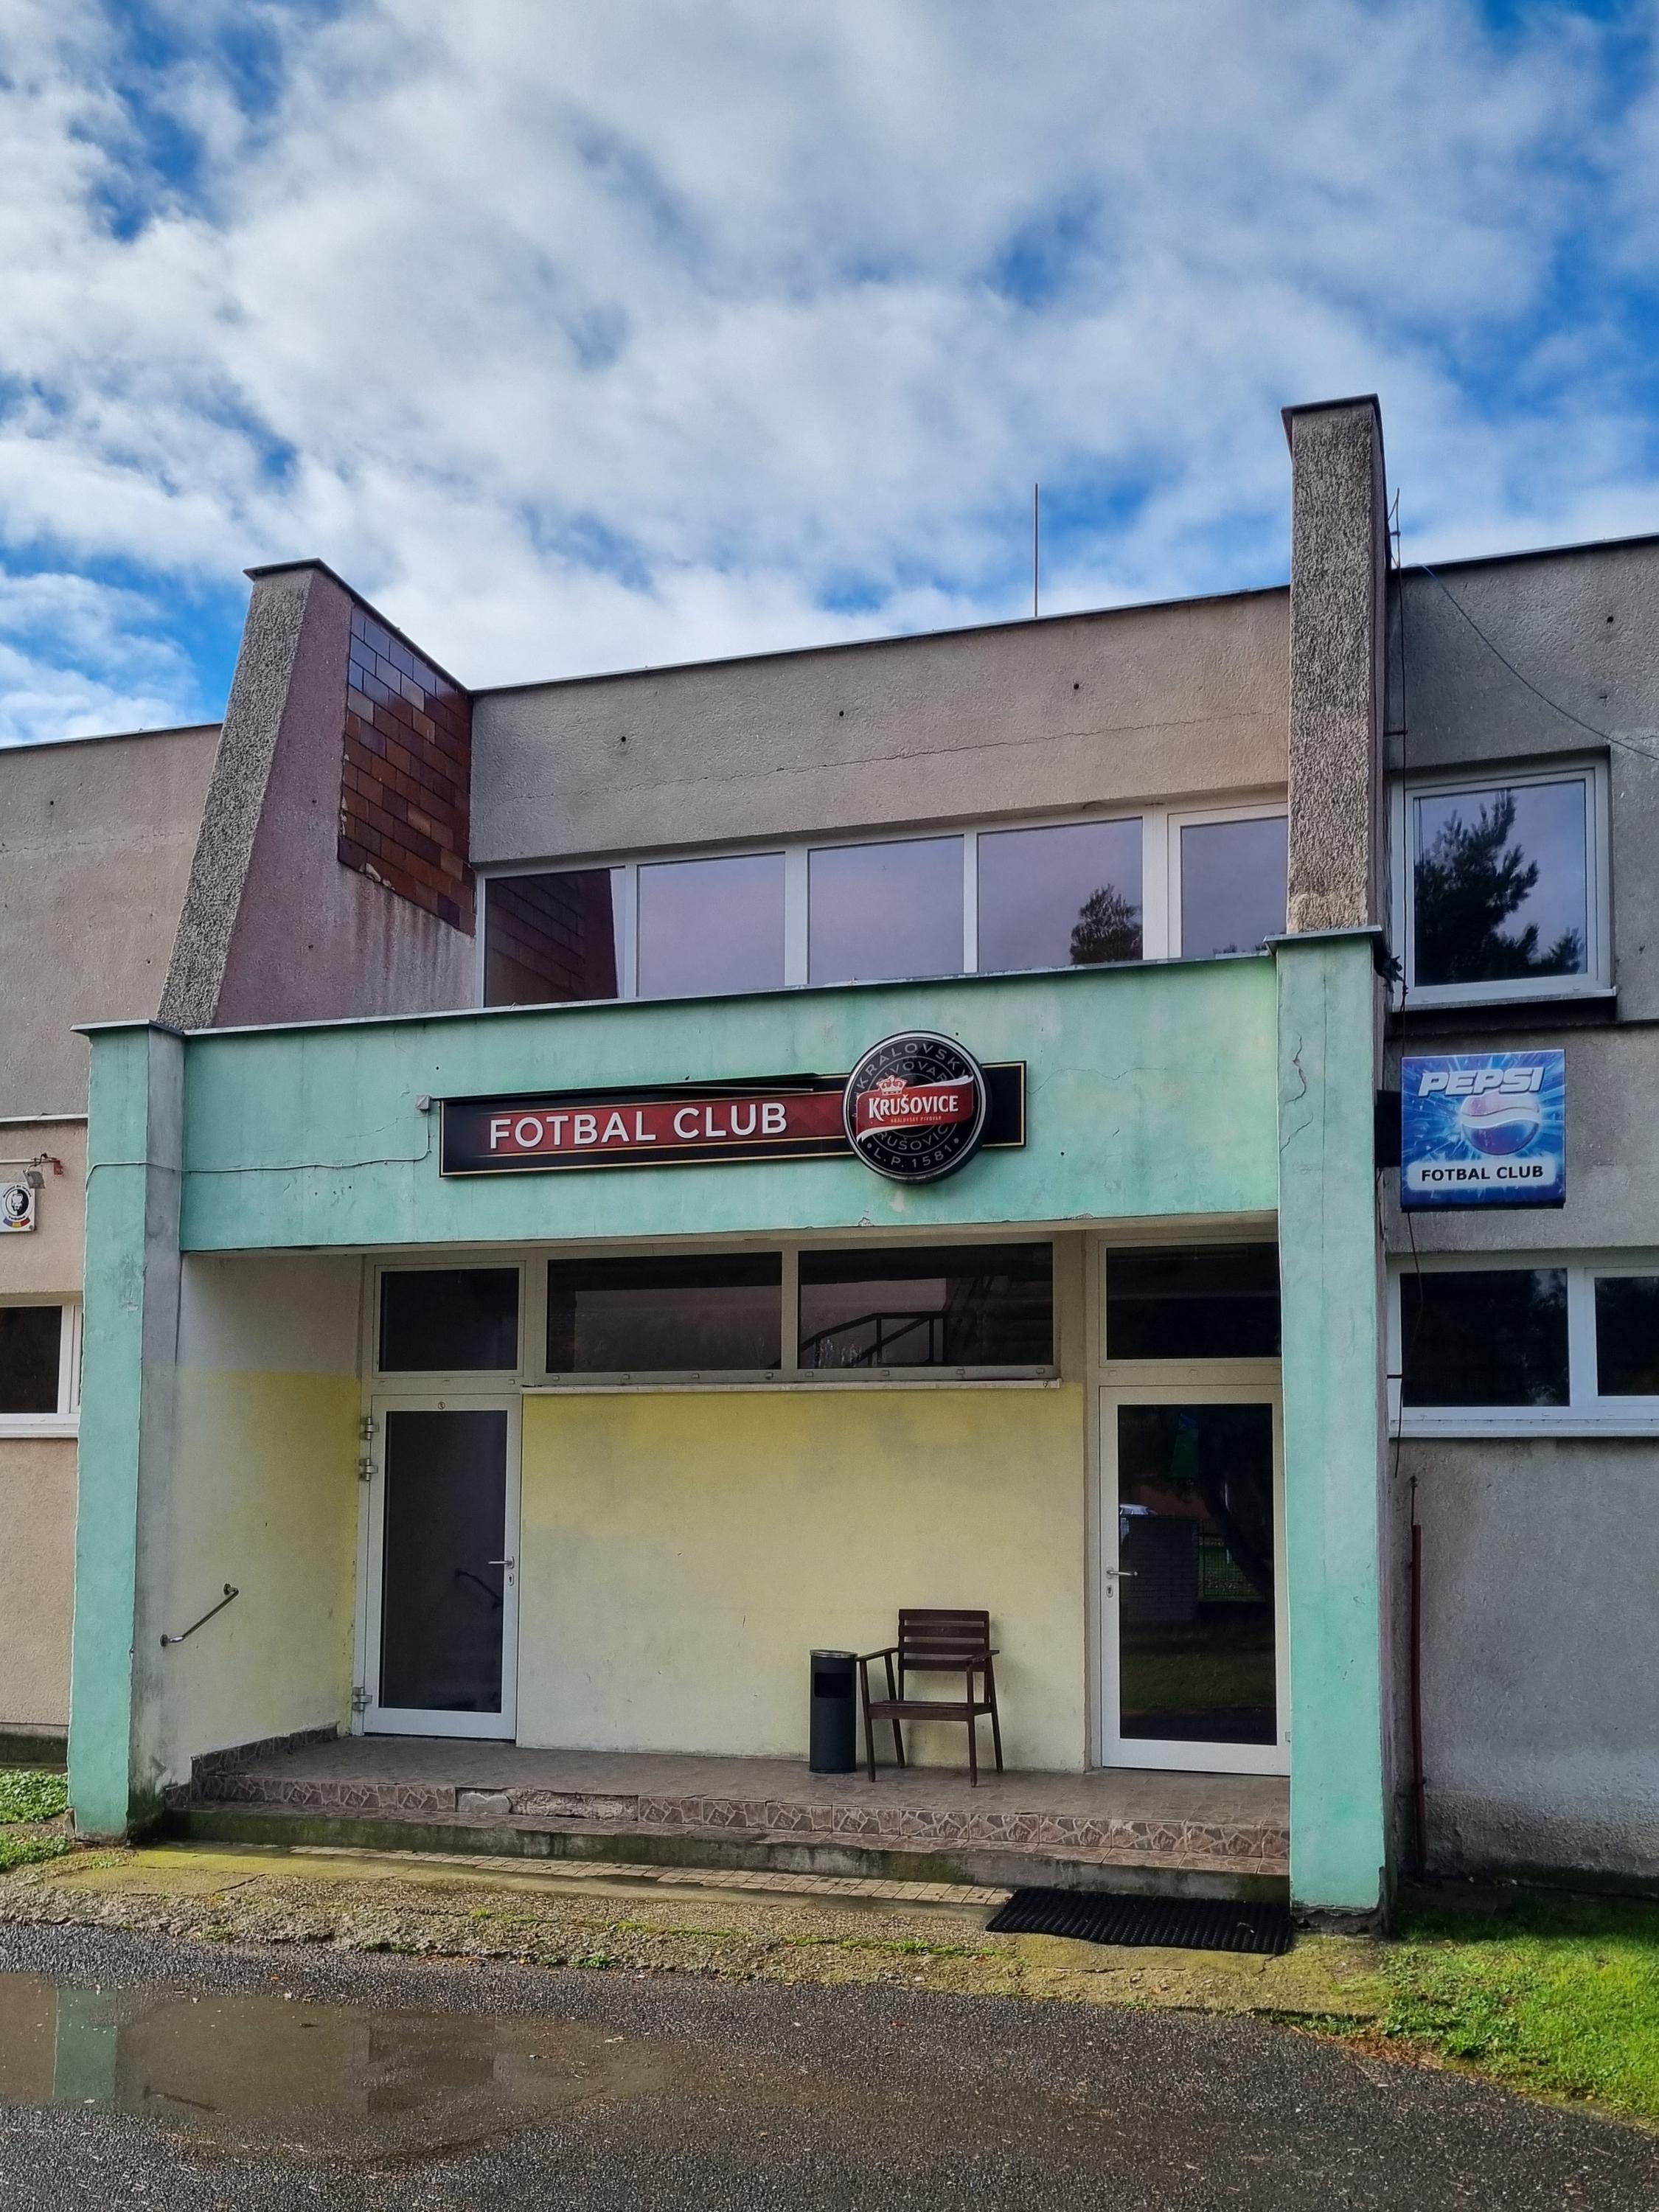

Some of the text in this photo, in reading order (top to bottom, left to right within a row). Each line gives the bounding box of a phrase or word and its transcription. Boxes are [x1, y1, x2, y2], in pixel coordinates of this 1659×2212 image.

[883, 1060, 947, 1081] VOVAR
[1418, 1067, 1545, 1097] PEPSI
[869, 1094, 959, 1121] KRUŠOVICE
[490, 1102, 787, 1150] FOTBAL CLUB
[877, 1125, 949, 1150] RUŠOVIC
[911, 1144, 953, 1168] 1581
[1421, 1166, 1544, 1182] FOTBAL CLUB
